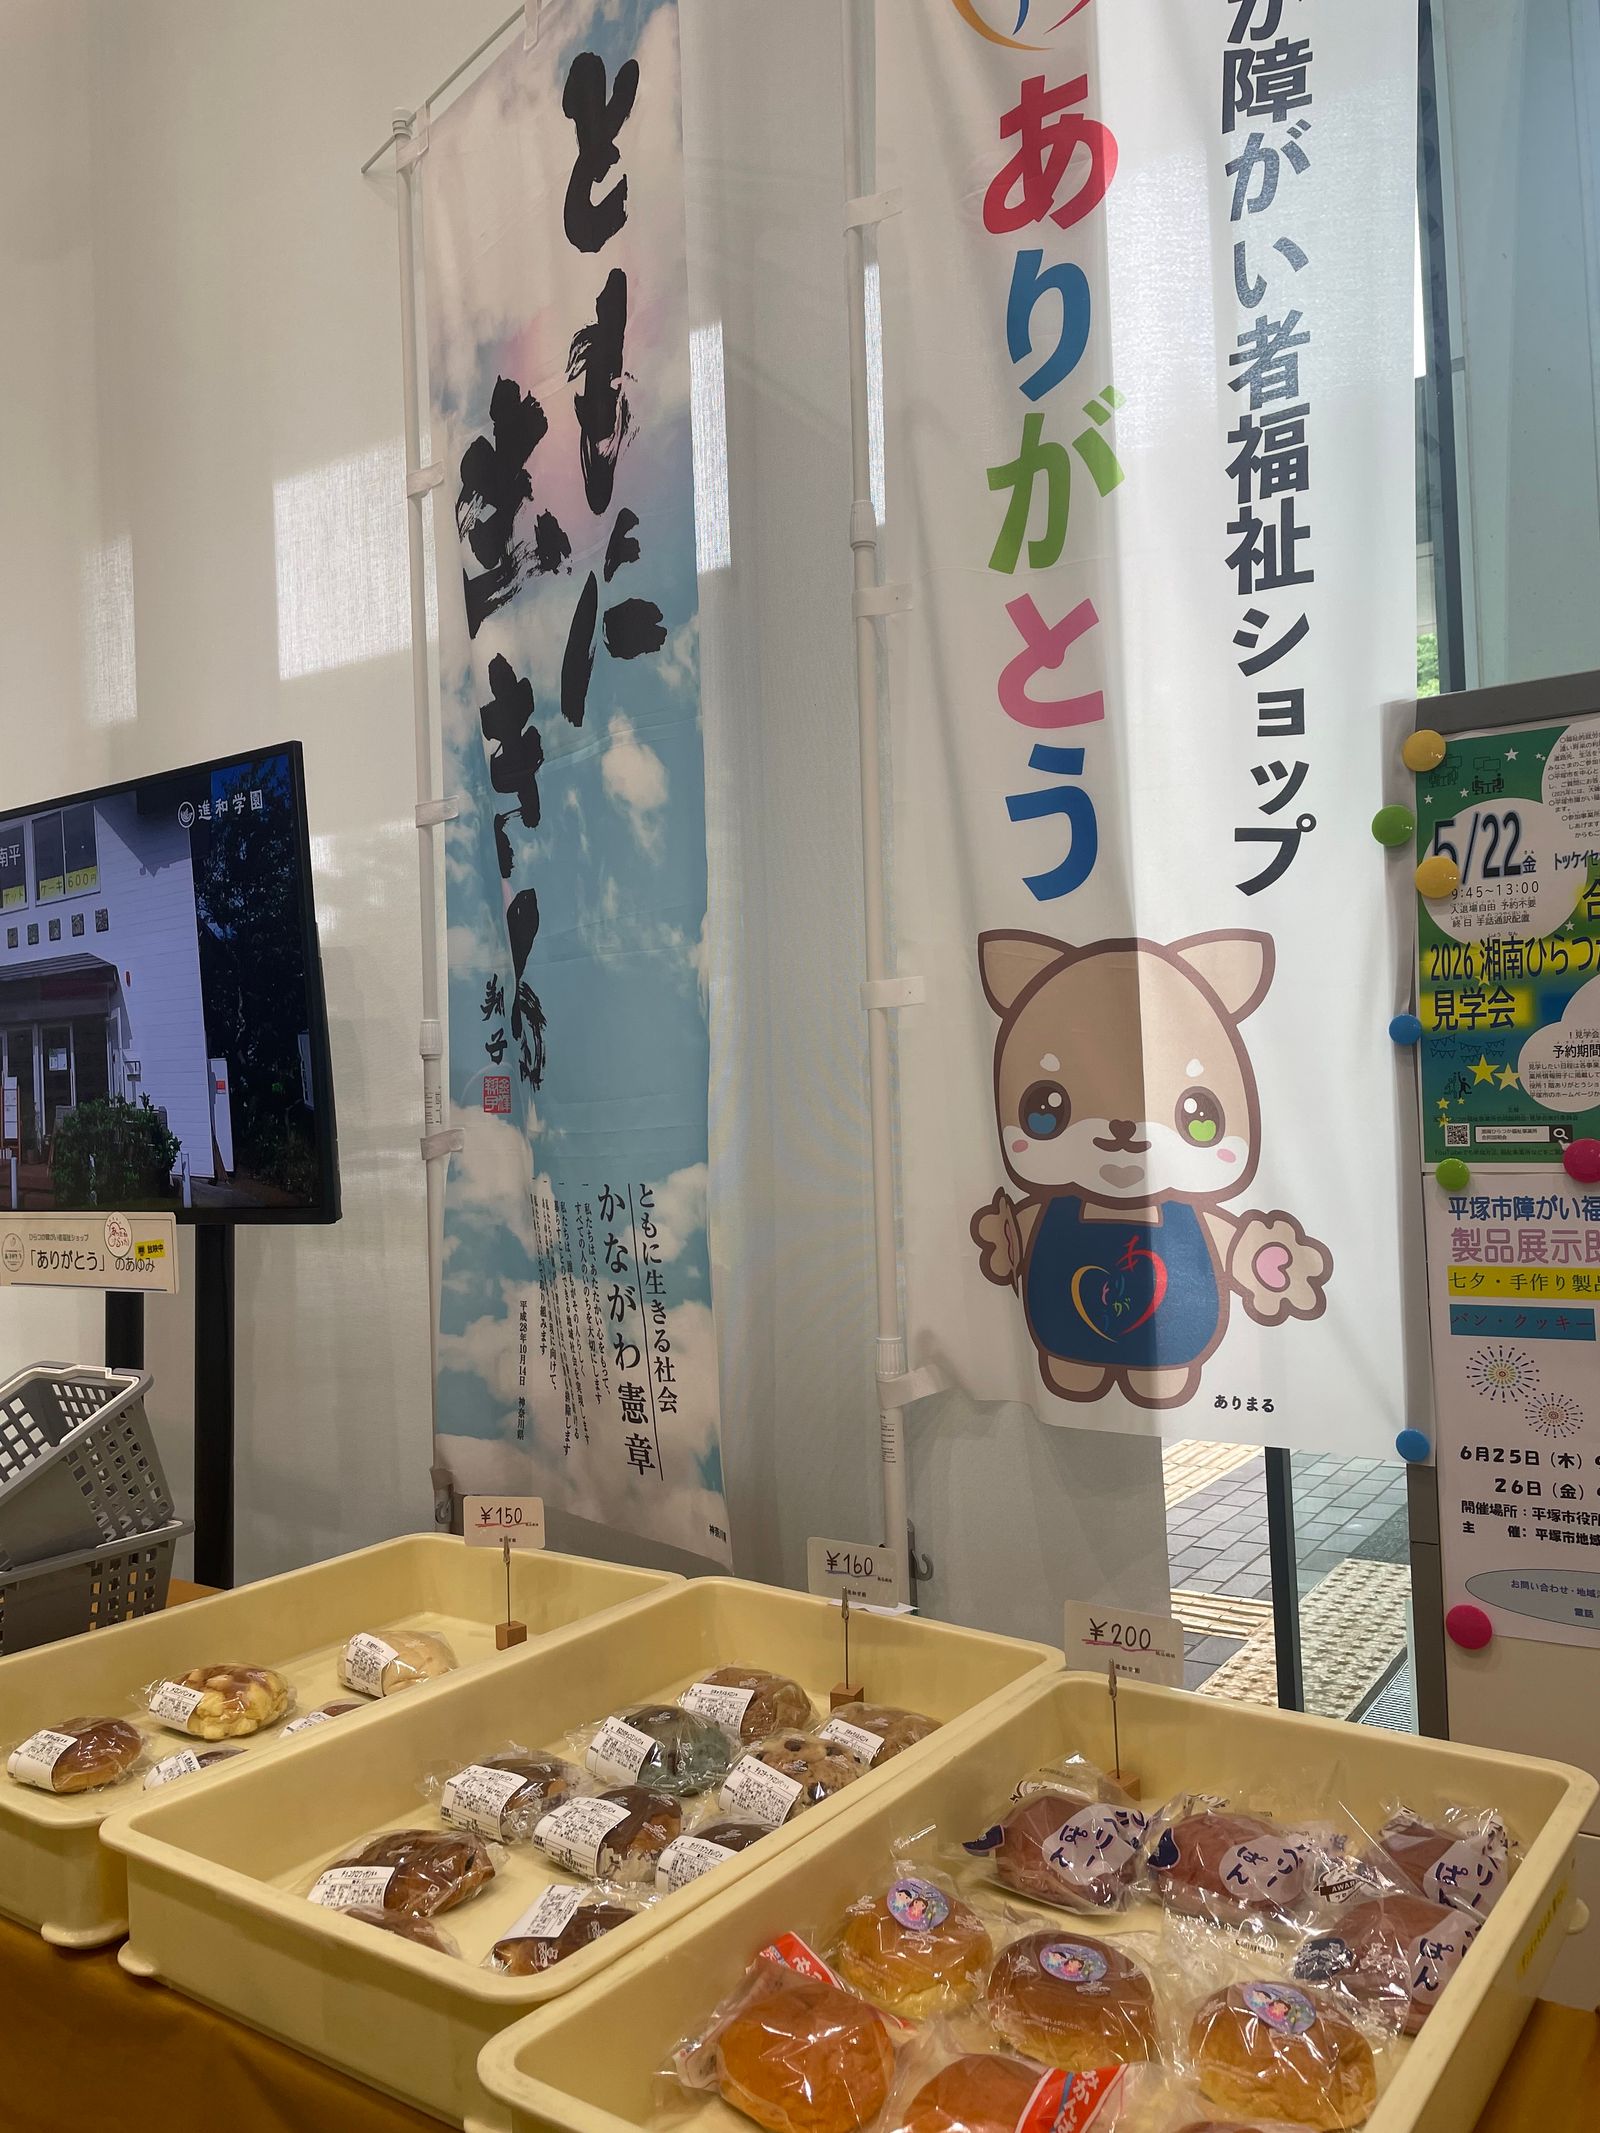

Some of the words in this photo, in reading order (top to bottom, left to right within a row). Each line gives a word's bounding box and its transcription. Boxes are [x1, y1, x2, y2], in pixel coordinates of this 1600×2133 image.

[982, 73, 1125, 901] ありがとう
[198, 789, 263, 821] 進和学園
[1430, 942, 1474, 982] 2026
[1431, 985, 1517, 1032] 見学会
[1552, 1044, 1600, 1059] 予約期間
[638, 1183, 679, 1415] ともに生きる社会
[598, 1183, 657, 1477] かながわ憲章
[1451, 1312, 1593, 1332] パン・クッキー
[1213, 1394, 1276, 1413] ありまる
[480, 1506, 523, 1525] ¥150
[826, 1550, 873, 1576] ¥160
[1089, 1618, 1151, 1650] ¥200
[1226, 1846, 1269, 1886] ぱん
